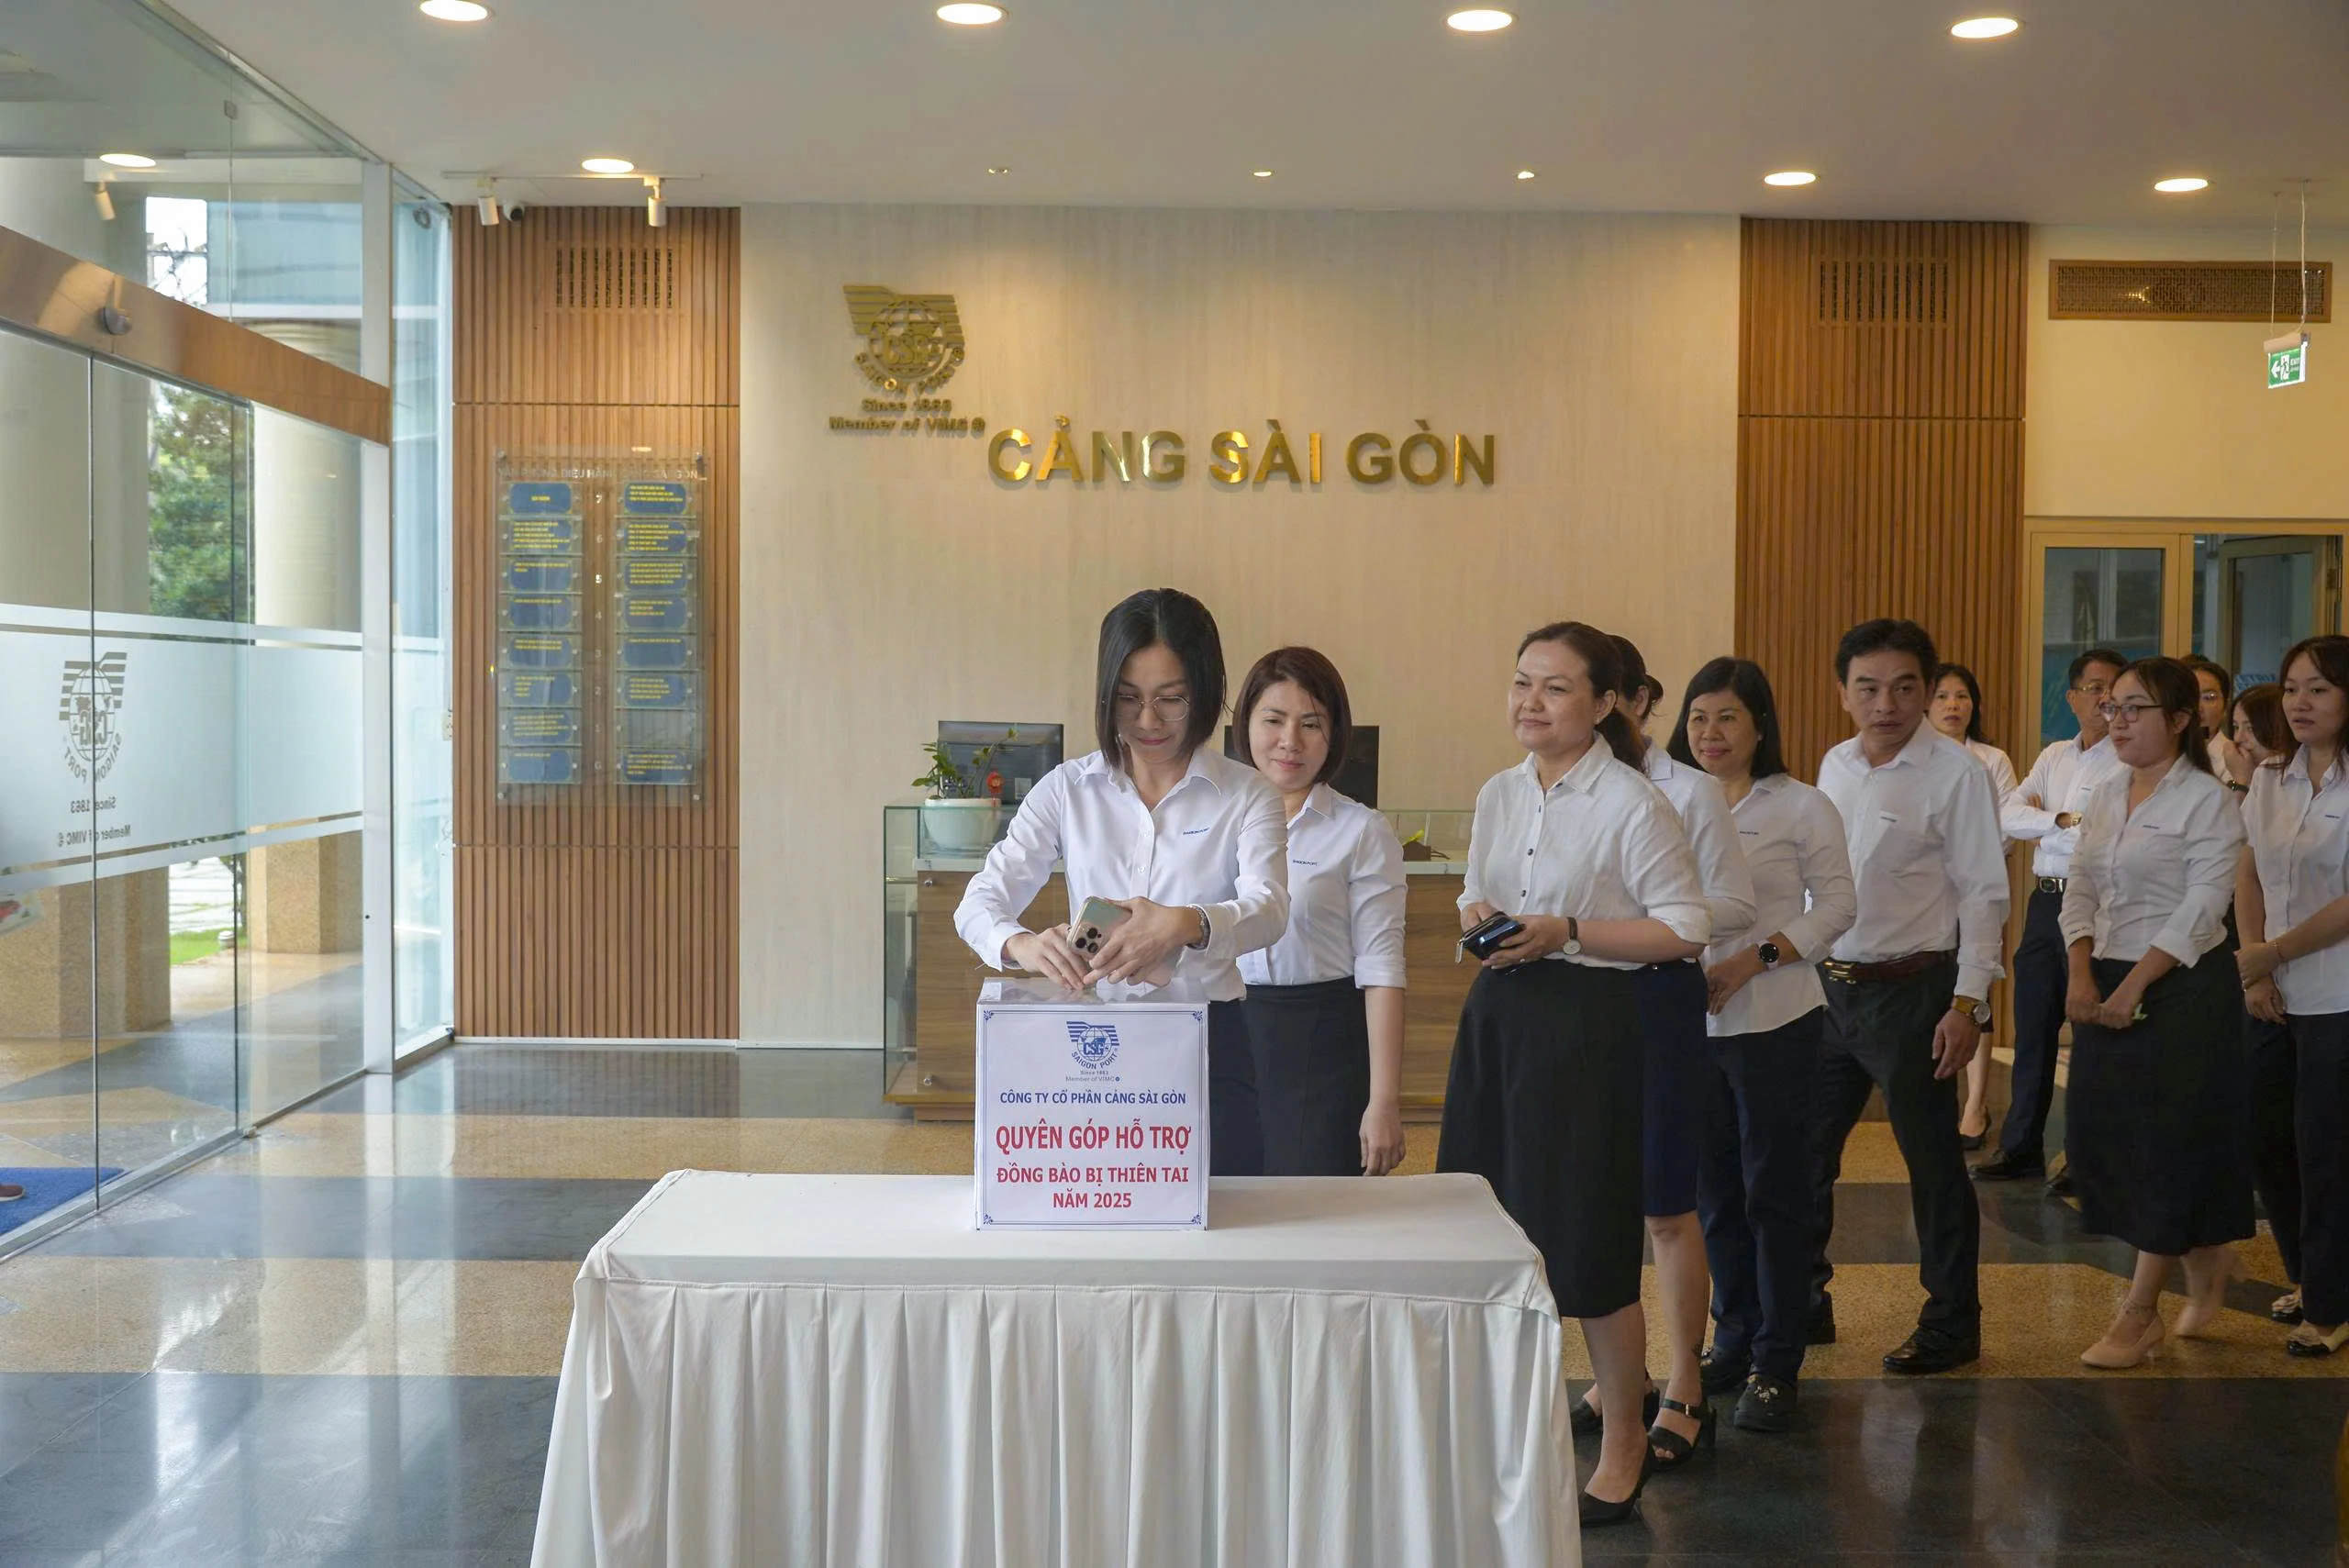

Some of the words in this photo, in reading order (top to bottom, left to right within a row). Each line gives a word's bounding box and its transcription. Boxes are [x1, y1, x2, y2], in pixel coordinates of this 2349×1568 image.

[987, 414, 1186, 484] CẢNG
[1208, 418, 1322, 484] SÀI
[1345, 418, 1495, 485] GÒN
[1071, 1051, 1097, 1070] SAIGON
[1099, 1052, 1118, 1069] PORT
[1000, 1089, 1032, 1104] CÔNG
[1035, 1093, 1049, 1104] TY
[1105, 1089, 1136, 1104] CẢNG
[1139, 1089, 1158, 1104] SÀI
[1162, 1089, 1186, 1104] GÒN
[996, 1118, 1063, 1155] QUYÊN
[1068, 1118, 1109, 1149] GÓP
[1116, 1118, 1144, 1149] HỖ
[1149, 1125, 1192, 1155] TRỢ
[996, 1162, 1043, 1183] ĐỒNG
[1049, 1162, 1081, 1183] BÀO
[1085, 1167, 1103, 1186] BỊ
[1108, 1162, 1157, 1183] THIÊN
[1162, 1167, 1189, 1183] TAI
[1052, 1187, 1088, 1208] NĂM
[1093, 1193, 1131, 1208] 2025
